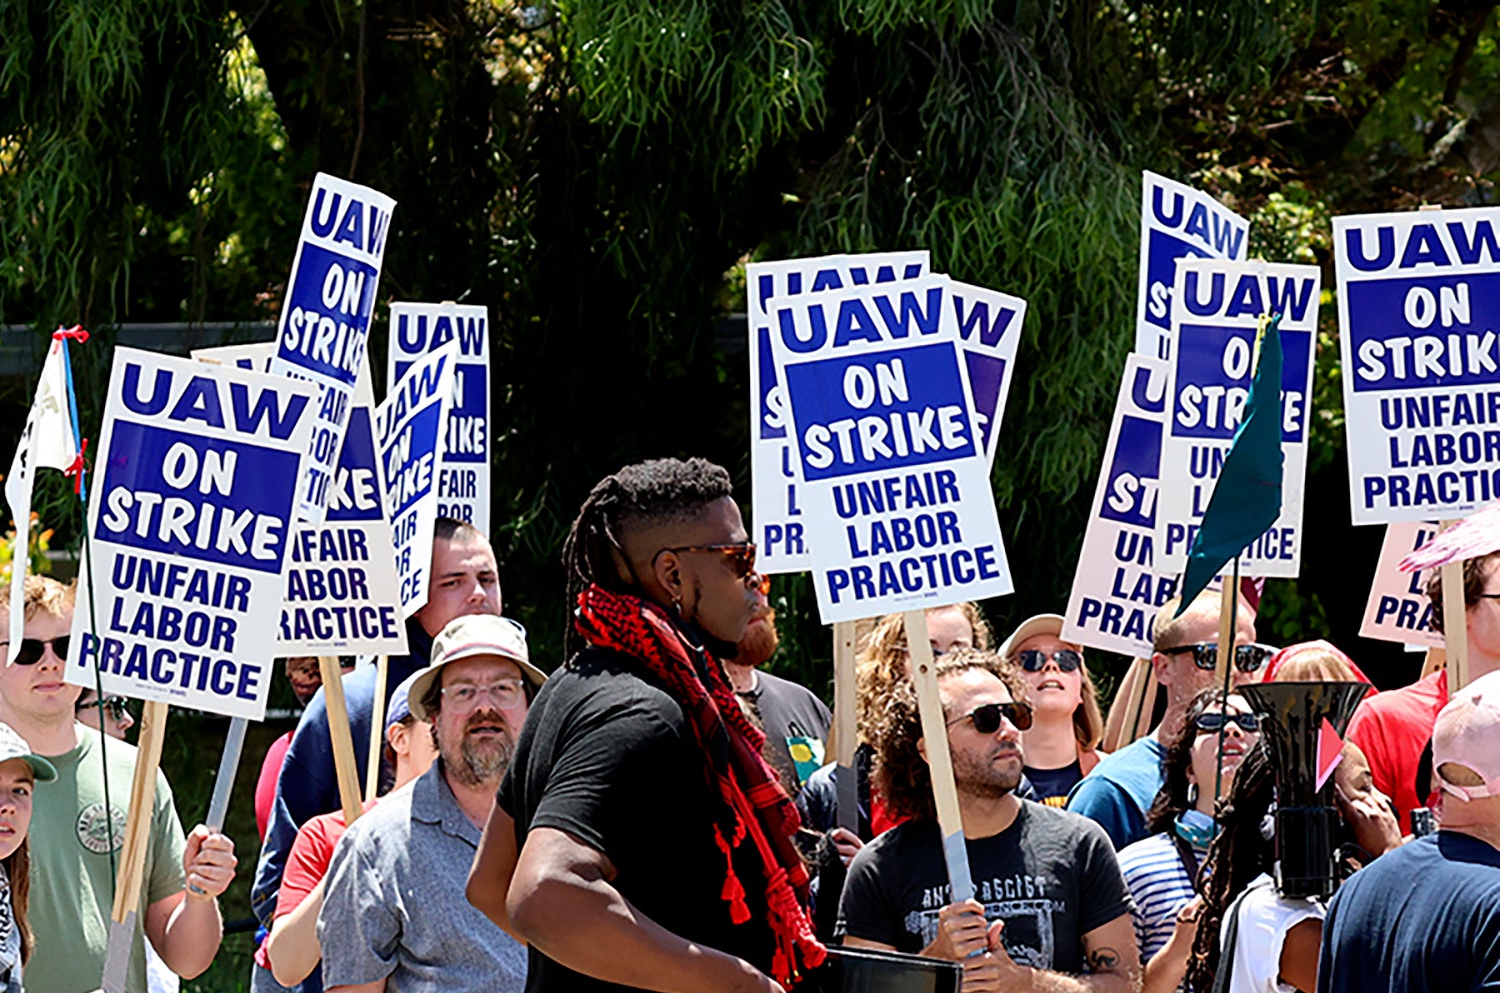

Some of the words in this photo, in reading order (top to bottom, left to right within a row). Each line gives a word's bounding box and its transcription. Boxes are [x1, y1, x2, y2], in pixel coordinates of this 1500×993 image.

[311, 187, 389, 258] UAW
[1151, 184, 1244, 260] UAW
[1346, 221, 1500, 273] UAW
[322, 262, 366, 316] ON
[1183, 269, 1315, 323] UAW
[1403, 282, 1471, 329] ON
[398, 314, 485, 357] UAW
[778, 287, 944, 354] UAW
[1222, 335, 1252, 381] O
[1357, 332, 1500, 382] STRIK
[121, 362, 310, 441] UAW
[842, 357, 910, 410] ON
[1176, 383, 1303, 433] STRE
[443, 414, 485, 456] IKE
[804, 404, 970, 470] STRIKE
[1389, 432, 1500, 470] LABOR
[162, 442, 238, 498] ON
[438, 469, 477, 499] FAIR
[832, 468, 961, 519] UNFAIR
[1363, 471, 1500, 510] PRACTI
[101, 485, 284, 561] STRIKE
[292, 528, 369, 562] FAIR
[846, 510, 962, 559] LABOR
[112, 554, 253, 613] UNFAIR
[286, 567, 370, 602] ABOR
[826, 545, 1001, 605] PRACTICE
[1111, 567, 1176, 608] LAB
[110, 596, 237, 653] LABOR
[277, 606, 399, 641] RACTICE
[78, 633, 262, 702] PRACTICE
